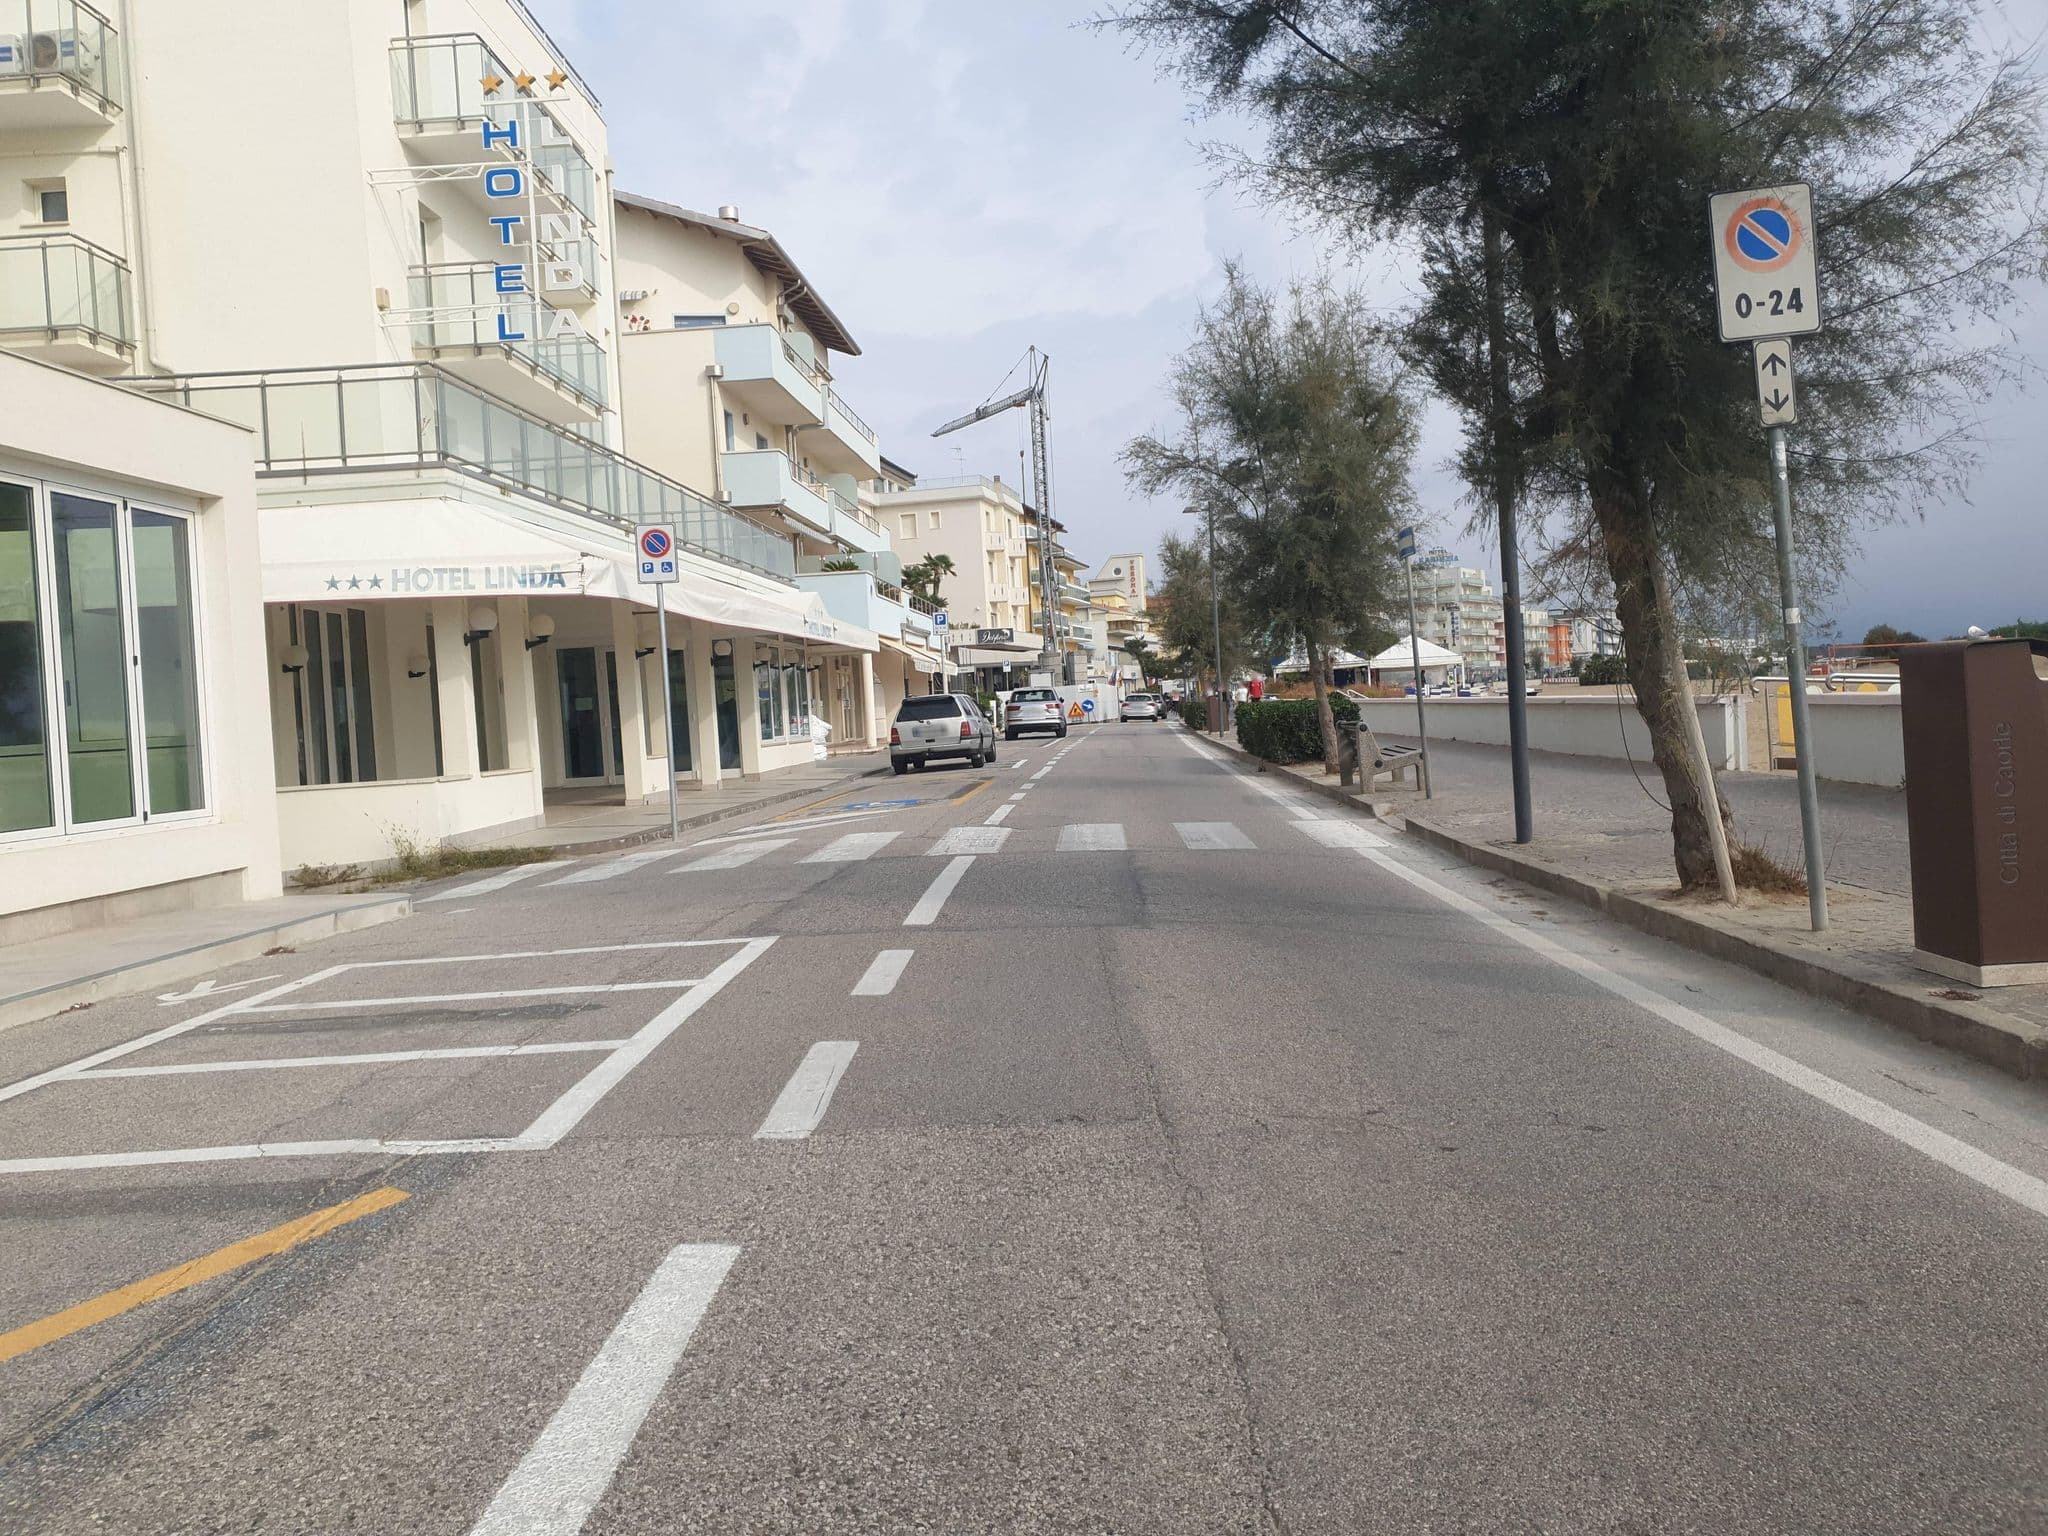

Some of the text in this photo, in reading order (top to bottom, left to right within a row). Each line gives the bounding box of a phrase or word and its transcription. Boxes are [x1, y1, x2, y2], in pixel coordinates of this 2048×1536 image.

[482, 119, 526, 341] HOTEL
[540, 116, 587, 339] LINDA
[1735, 287, 1804, 319] 0-24
[391, 563, 567, 593] HOTEL LINDA
[1129, 559, 1137, 594] VERONA
[936, 615, 944, 624] P
[1992, 720, 2016, 798] Caorle
[1995, 805, 2017, 825] di
